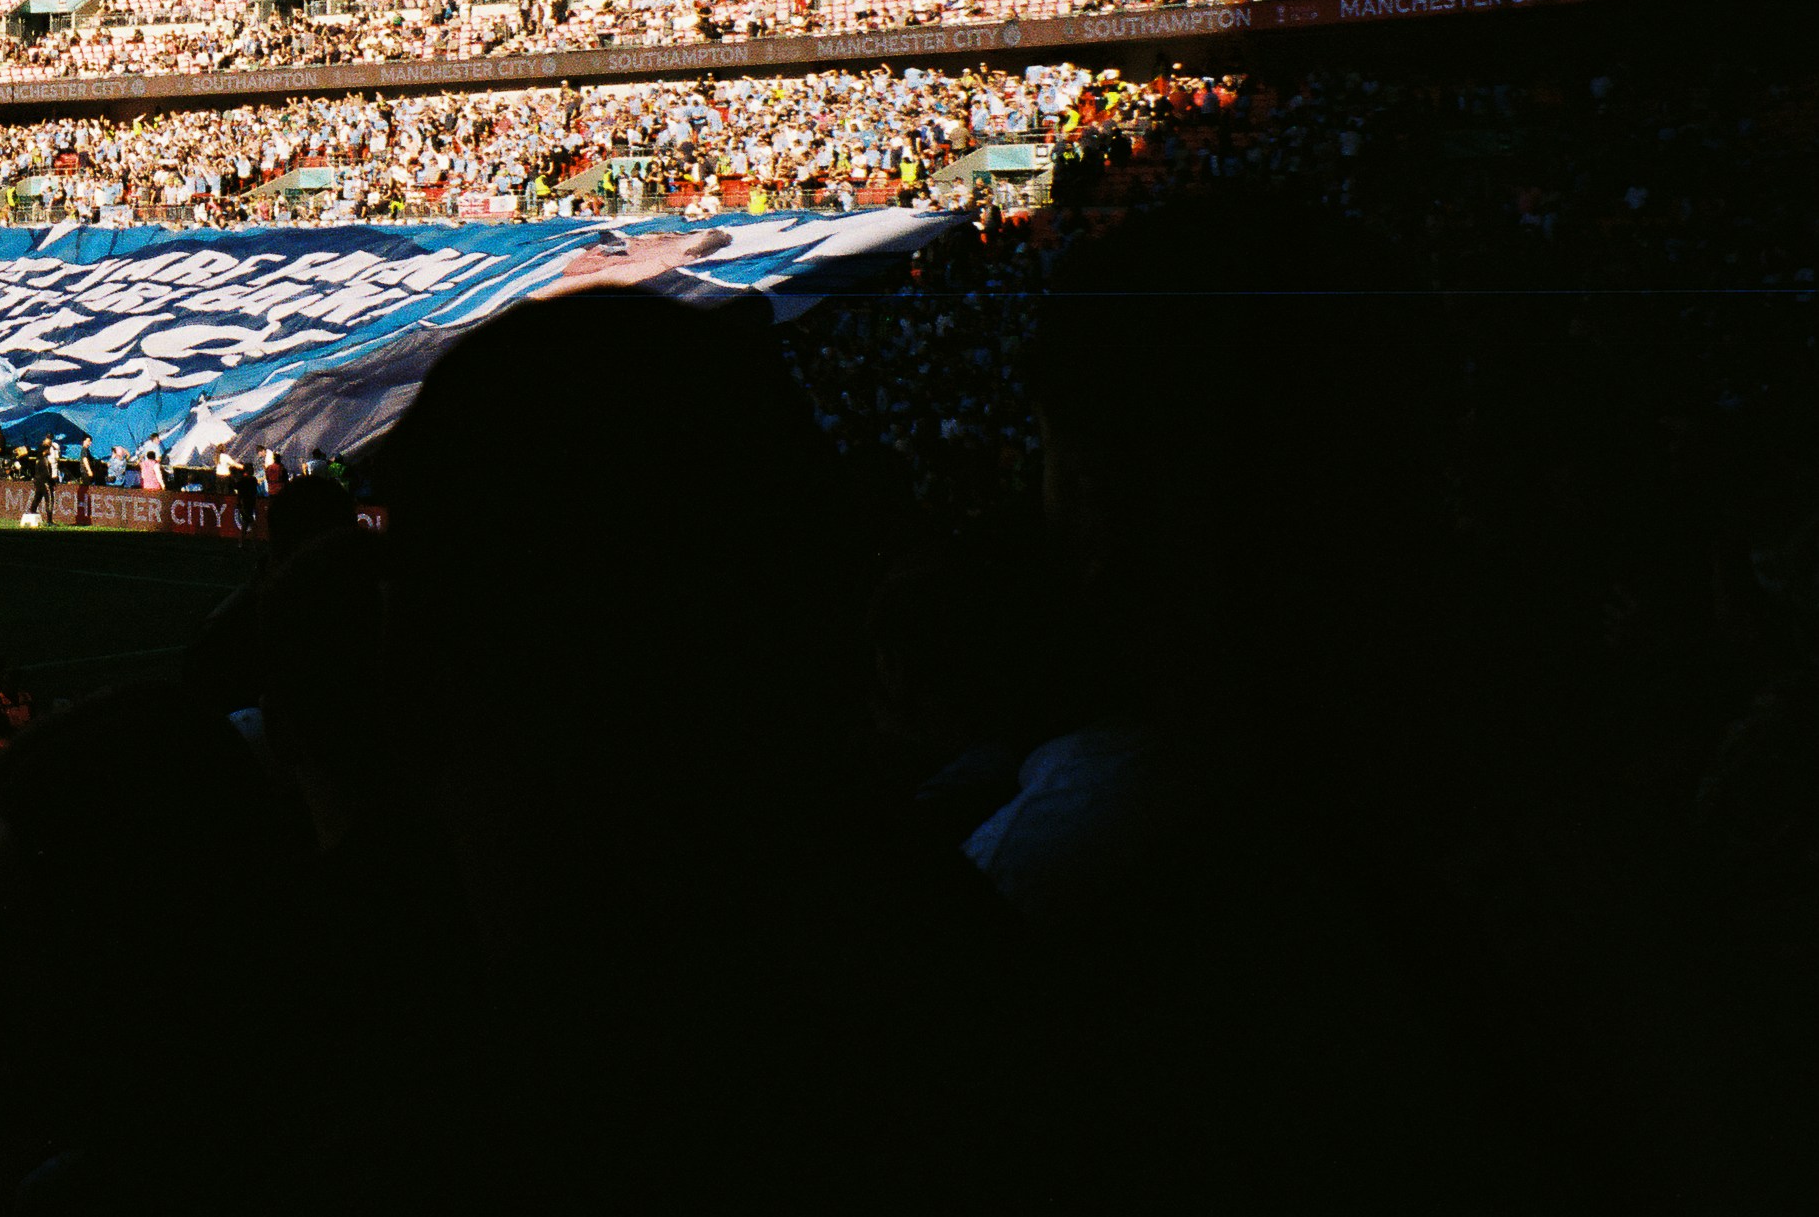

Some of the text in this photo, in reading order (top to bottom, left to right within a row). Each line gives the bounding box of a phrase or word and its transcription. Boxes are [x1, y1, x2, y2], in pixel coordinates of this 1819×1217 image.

[1083, 9, 1253, 39] SOUTHAMPTON
[816, 27, 1002, 57] MANCHESTER CITY
[385, 58, 538, 83] MANCHESTER CITY
[608, 45, 749, 72] SOUTHAMPTON
[96, 81, 128, 96] CITY
[191, 71, 318, 92] SOUTHAMPTON
[170, 498, 228, 529] CITY
